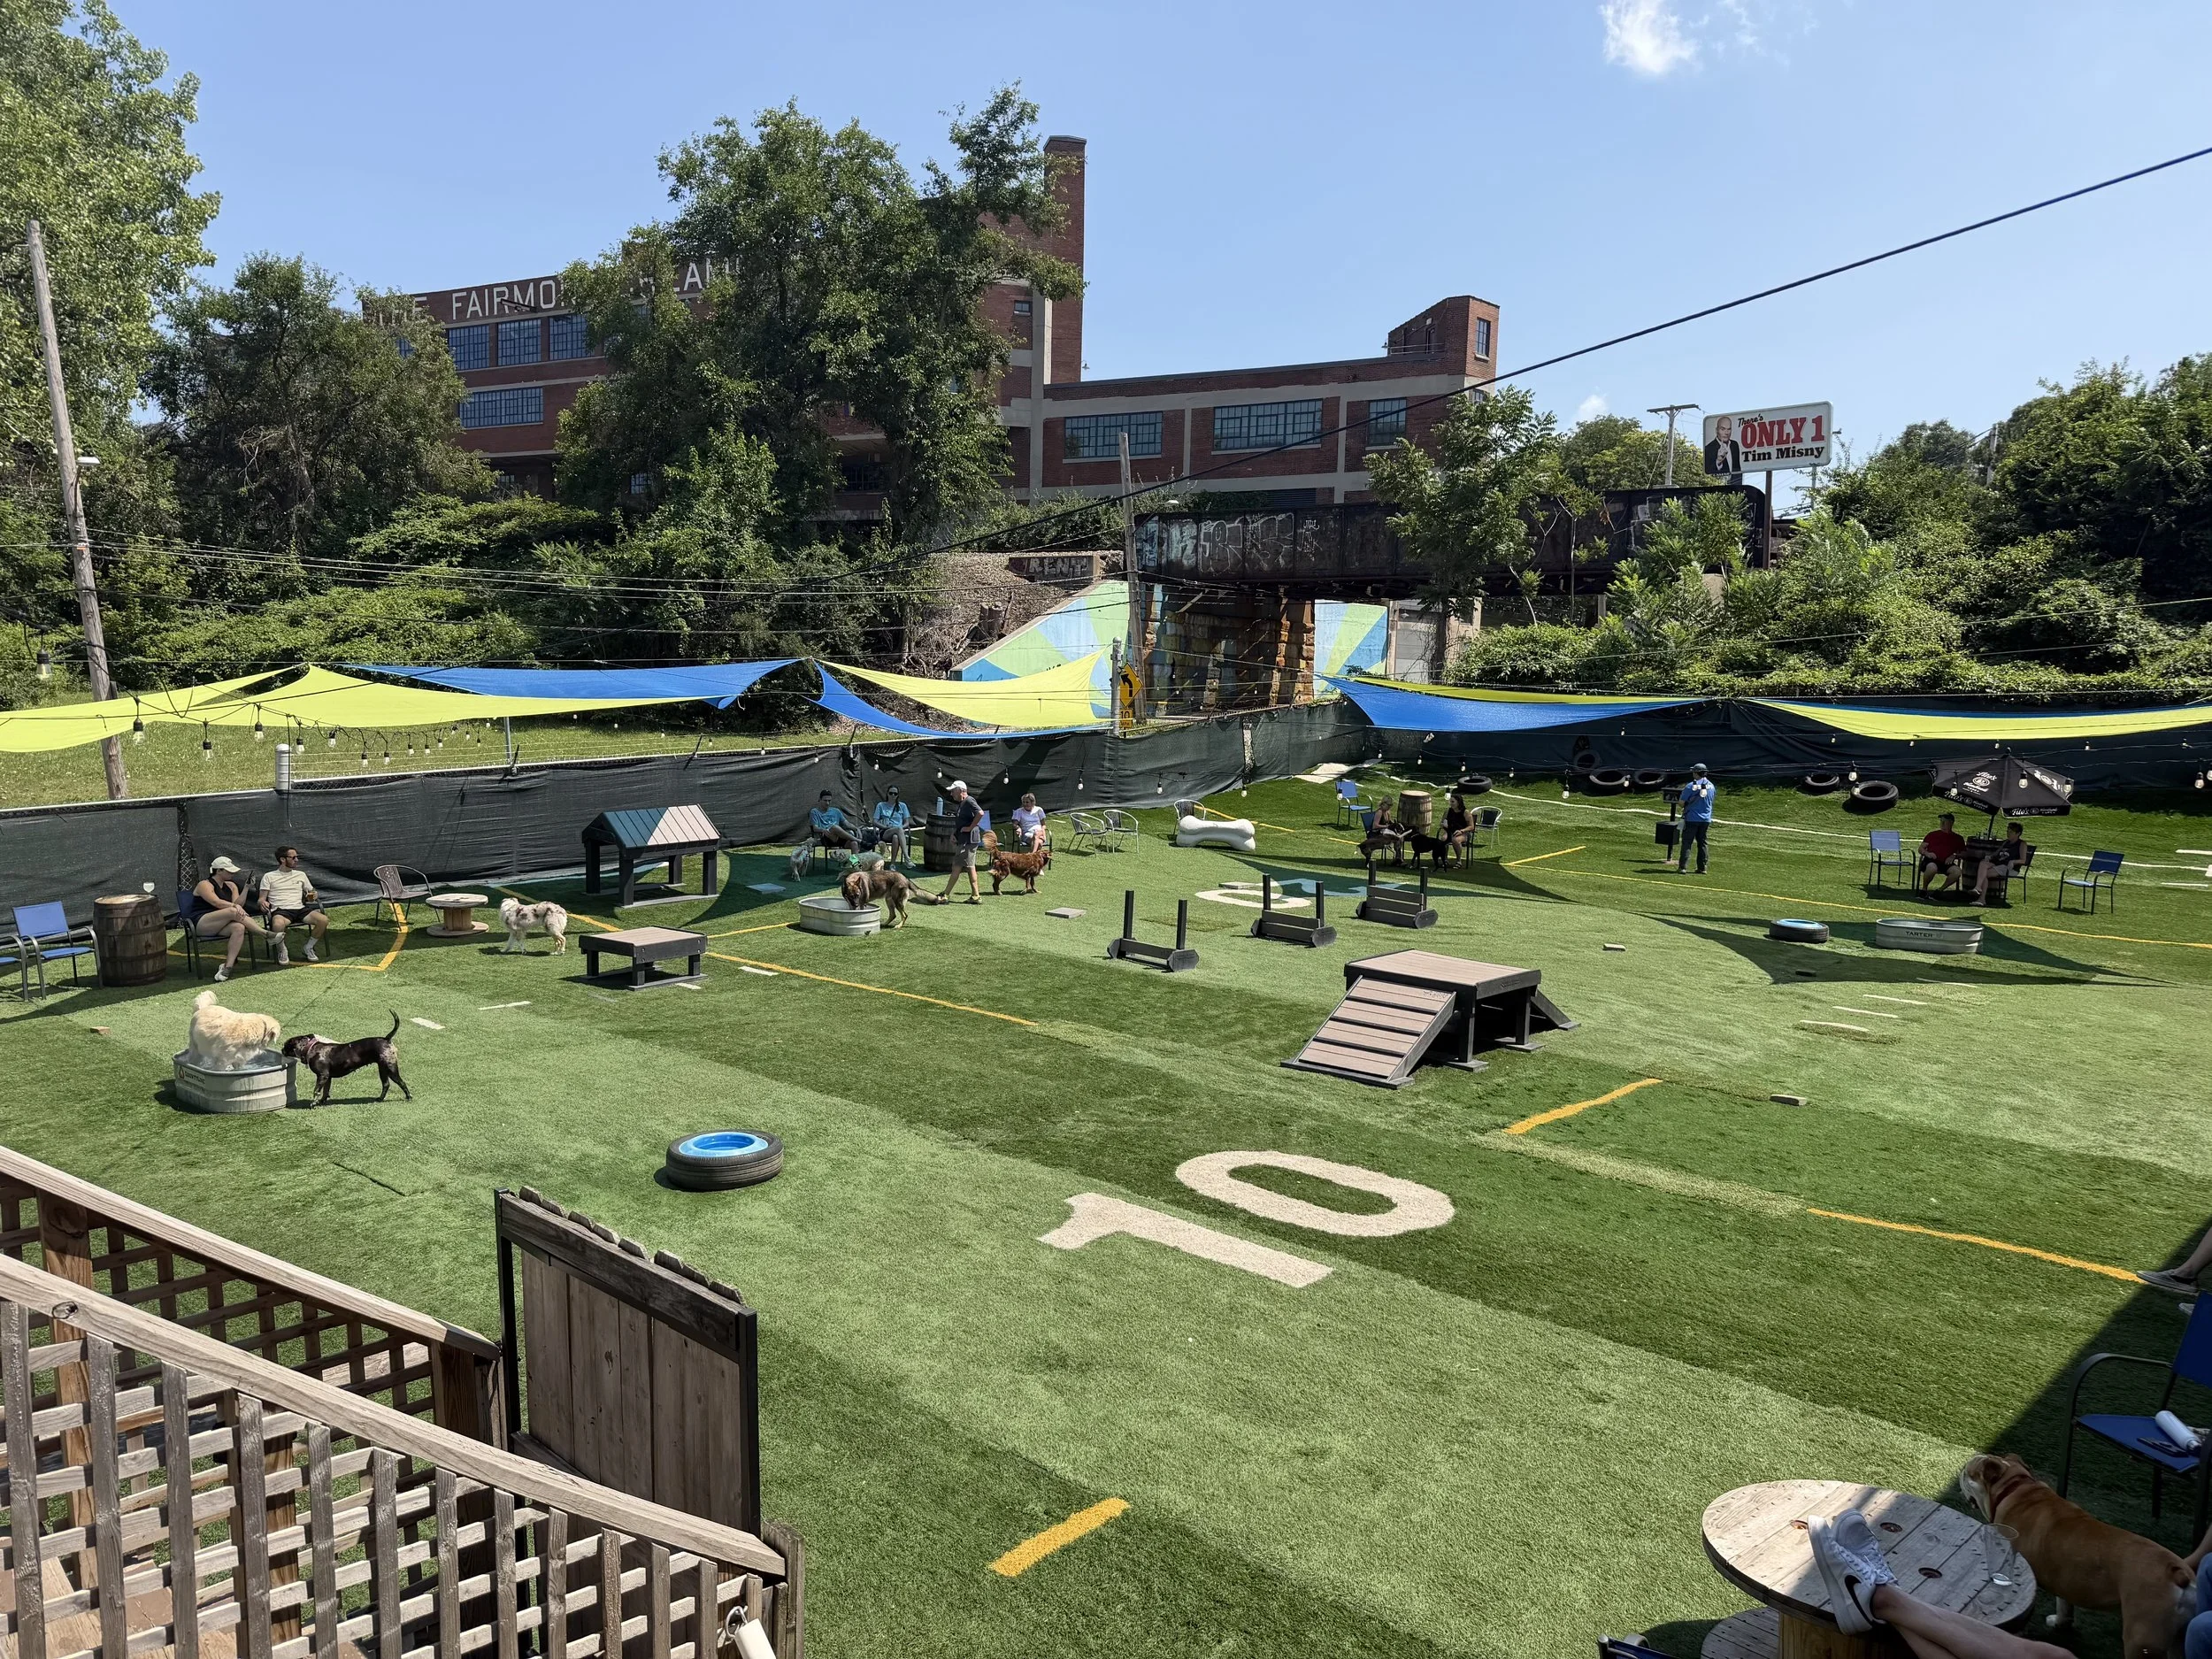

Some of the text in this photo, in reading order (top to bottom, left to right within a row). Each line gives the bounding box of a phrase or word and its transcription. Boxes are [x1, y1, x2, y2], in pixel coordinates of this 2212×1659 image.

[1738, 413, 1763, 427] There's
[1741, 415, 1824, 449] ONLY 1
[1741, 446, 1824, 462] Tim Misny
[1035, 1150, 1455, 1289] 10
